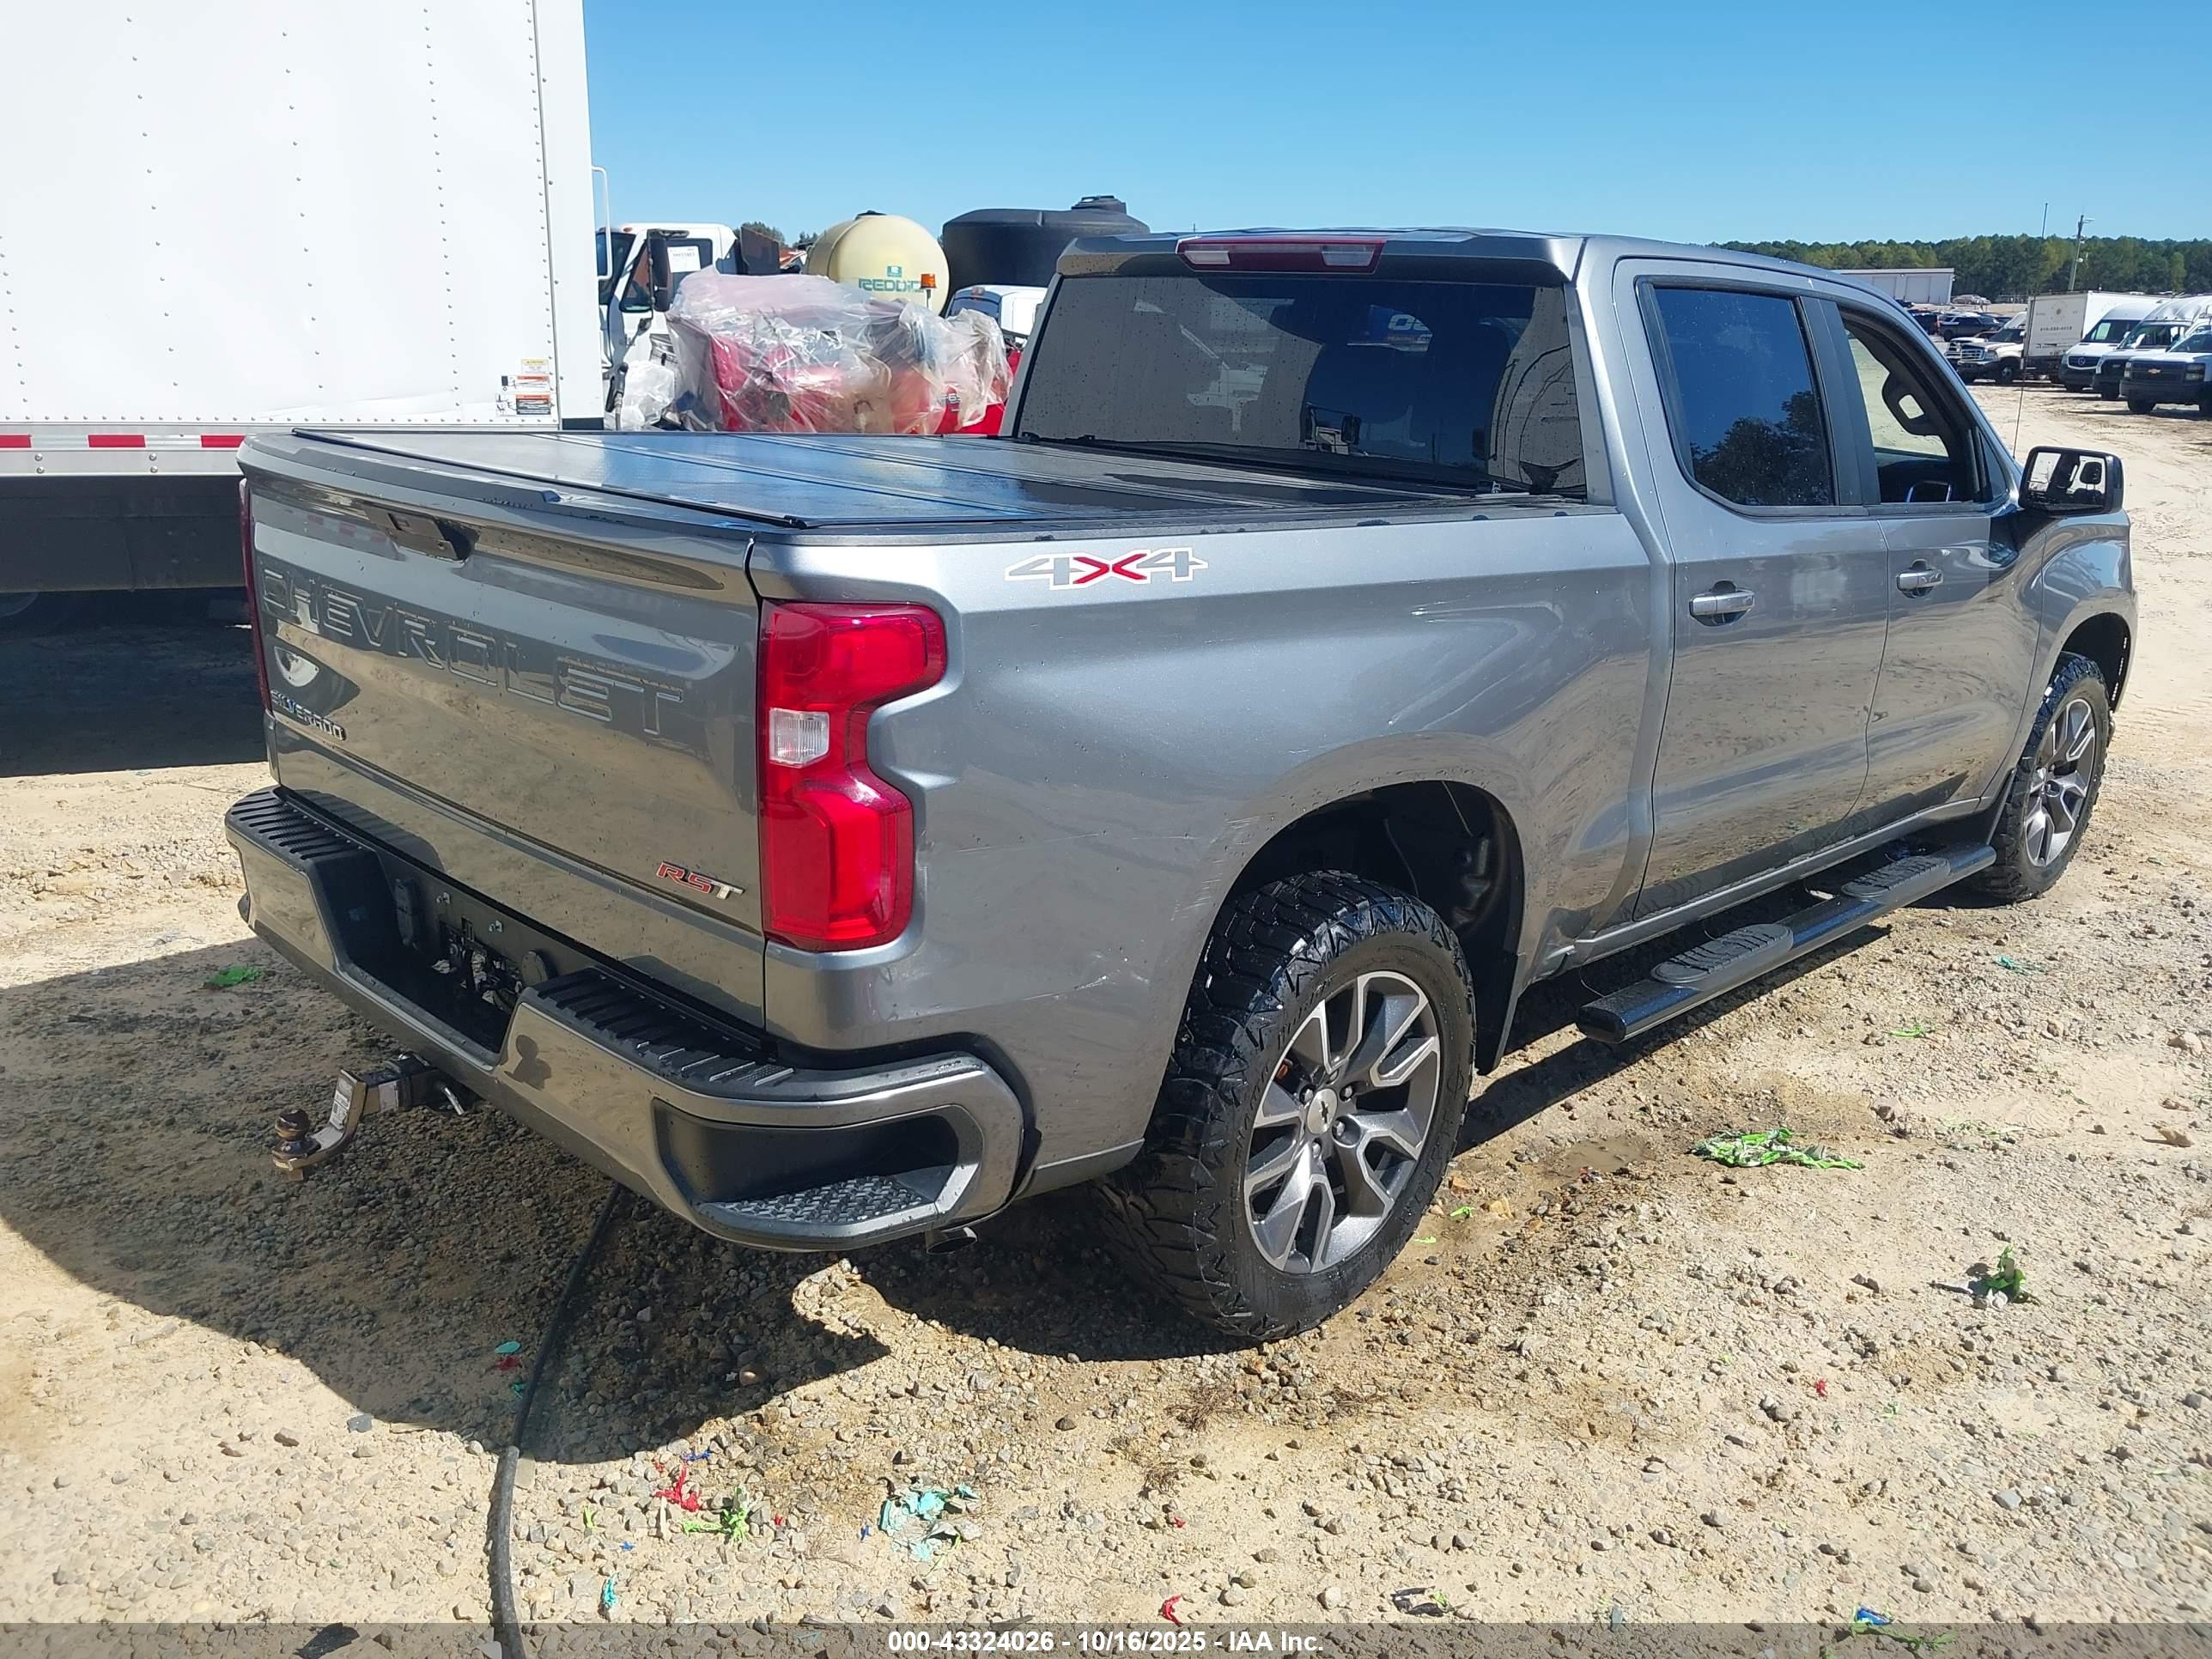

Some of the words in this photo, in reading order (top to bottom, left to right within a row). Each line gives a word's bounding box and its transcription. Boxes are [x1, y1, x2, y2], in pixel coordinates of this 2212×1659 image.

[262, 567, 684, 736] CHEVROLET
[270, 690, 345, 741] SILVERADO
[655, 860, 745, 901] RST
